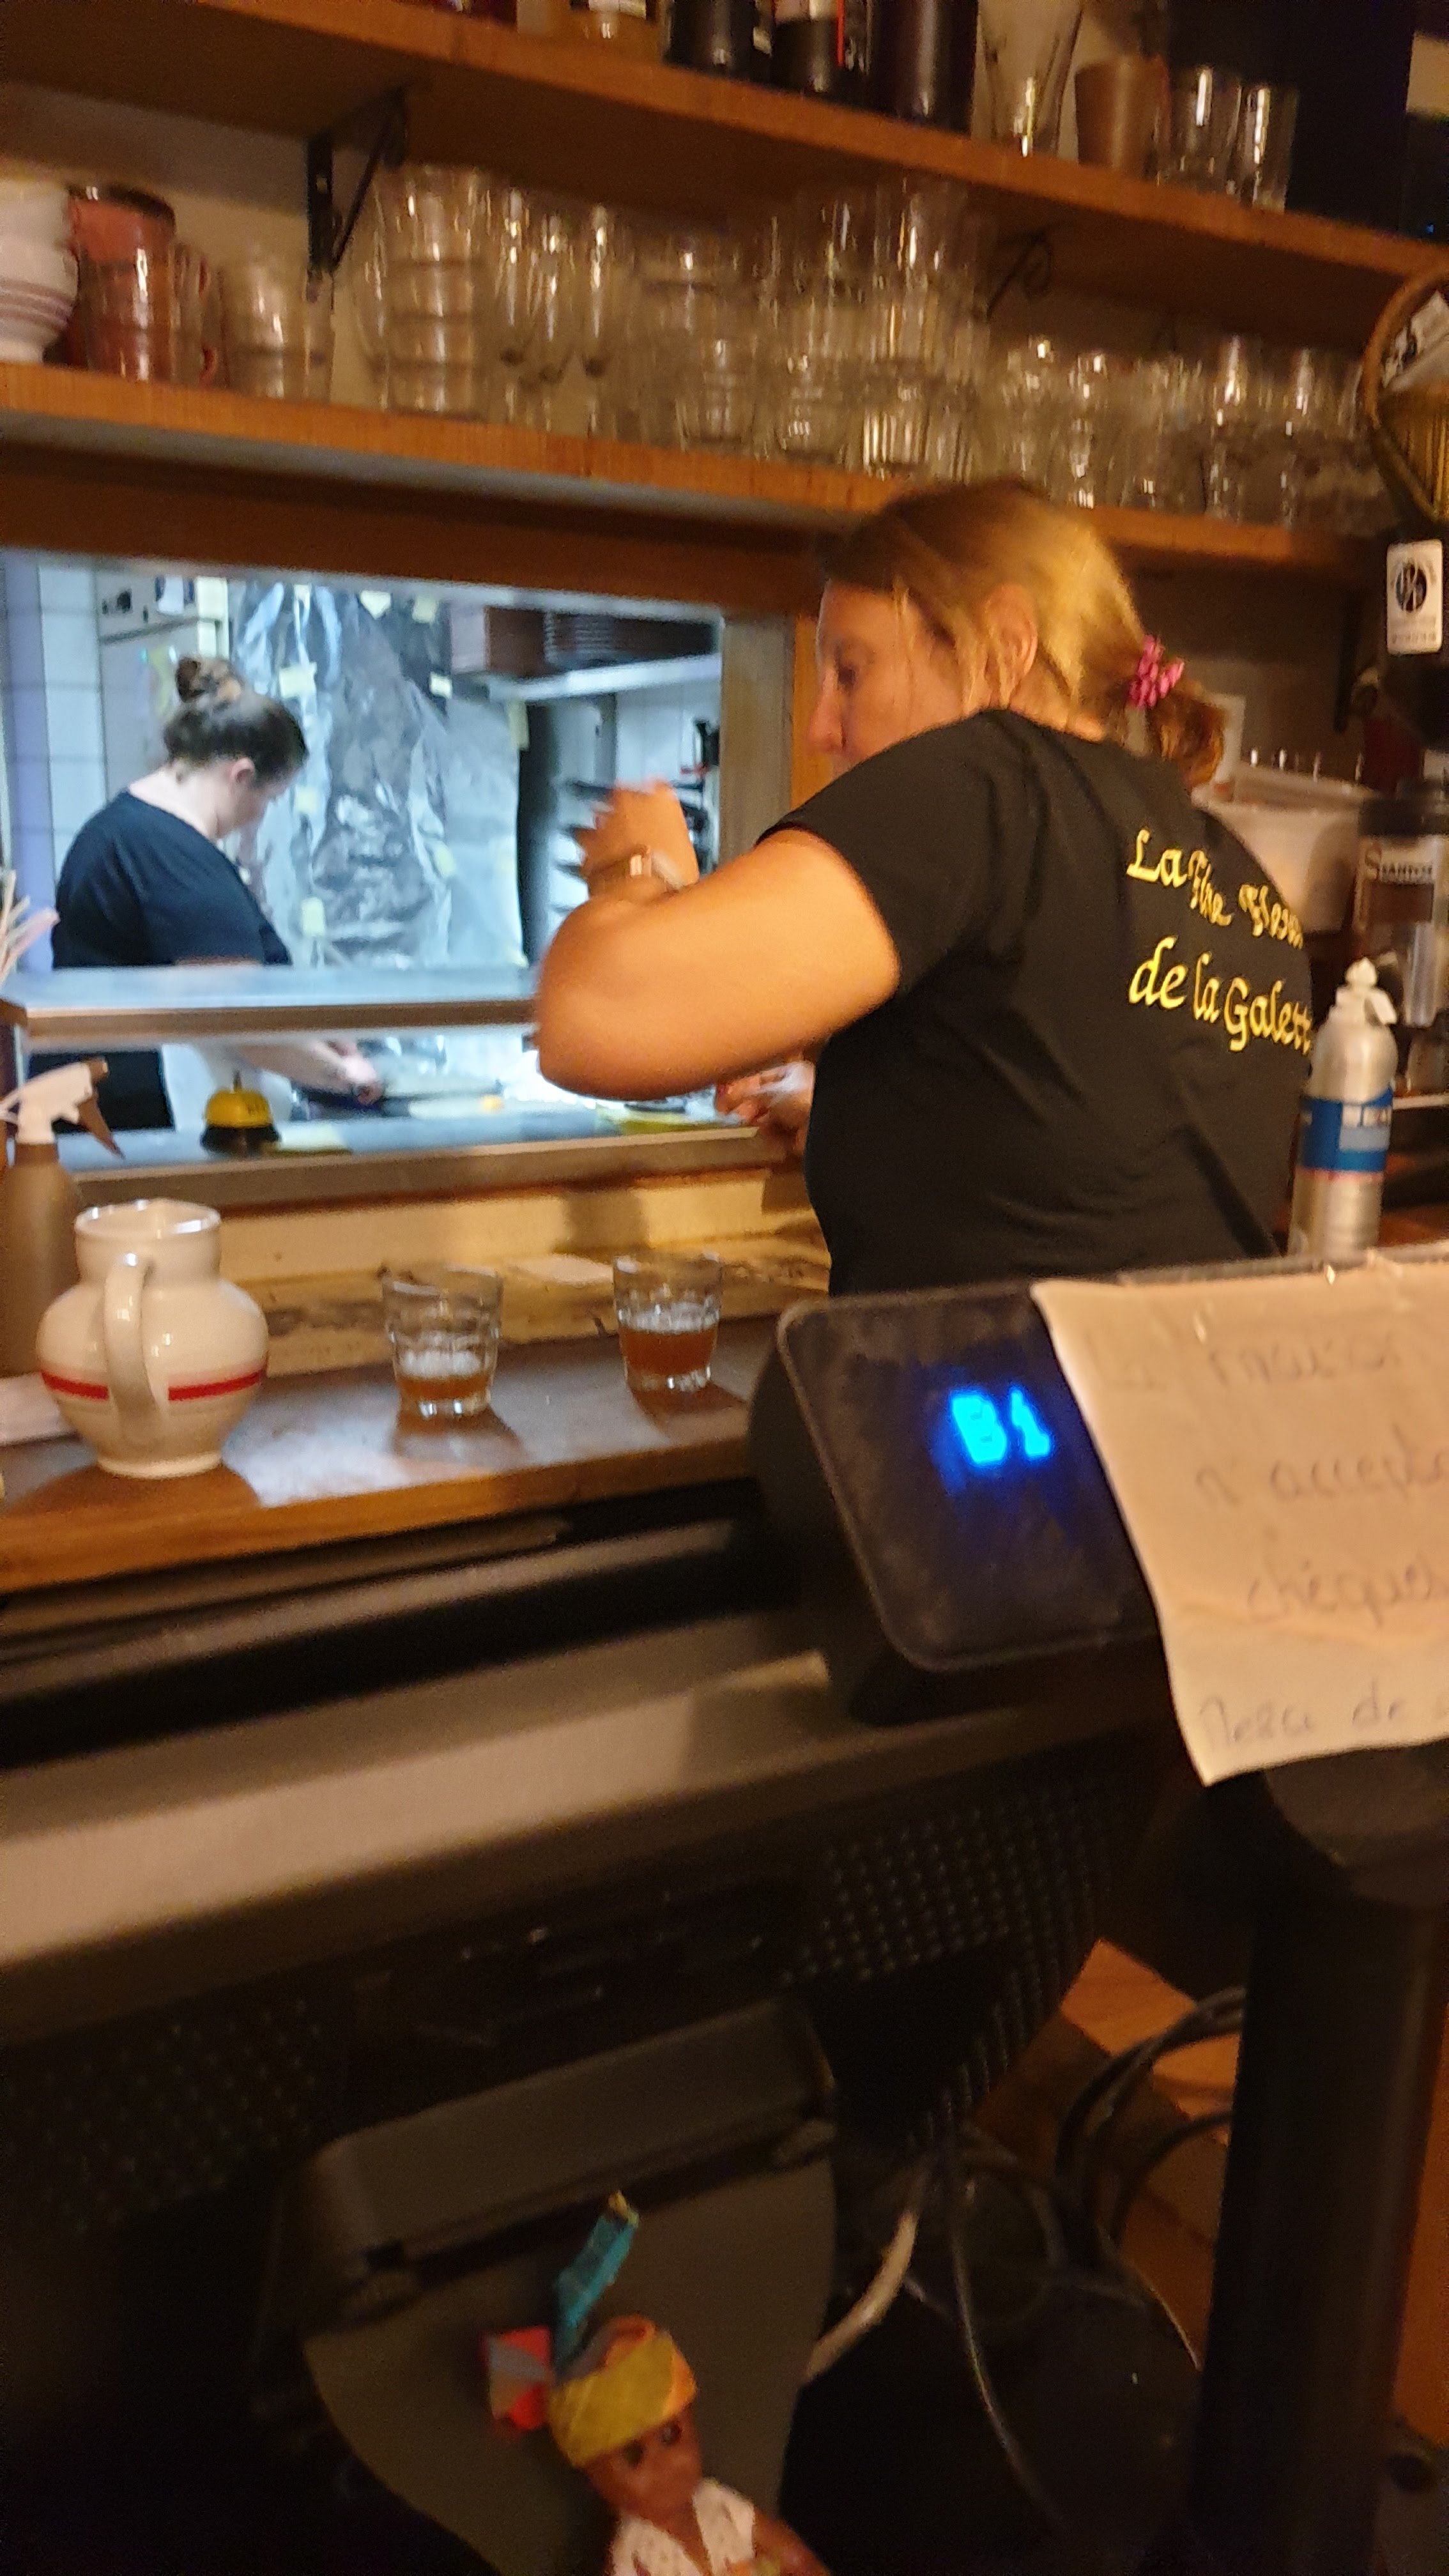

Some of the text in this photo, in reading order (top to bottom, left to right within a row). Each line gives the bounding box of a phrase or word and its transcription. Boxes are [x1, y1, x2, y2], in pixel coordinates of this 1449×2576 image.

[1126, 829, 1187, 888] La
[1129, 935, 1312, 1054] de la Galett
